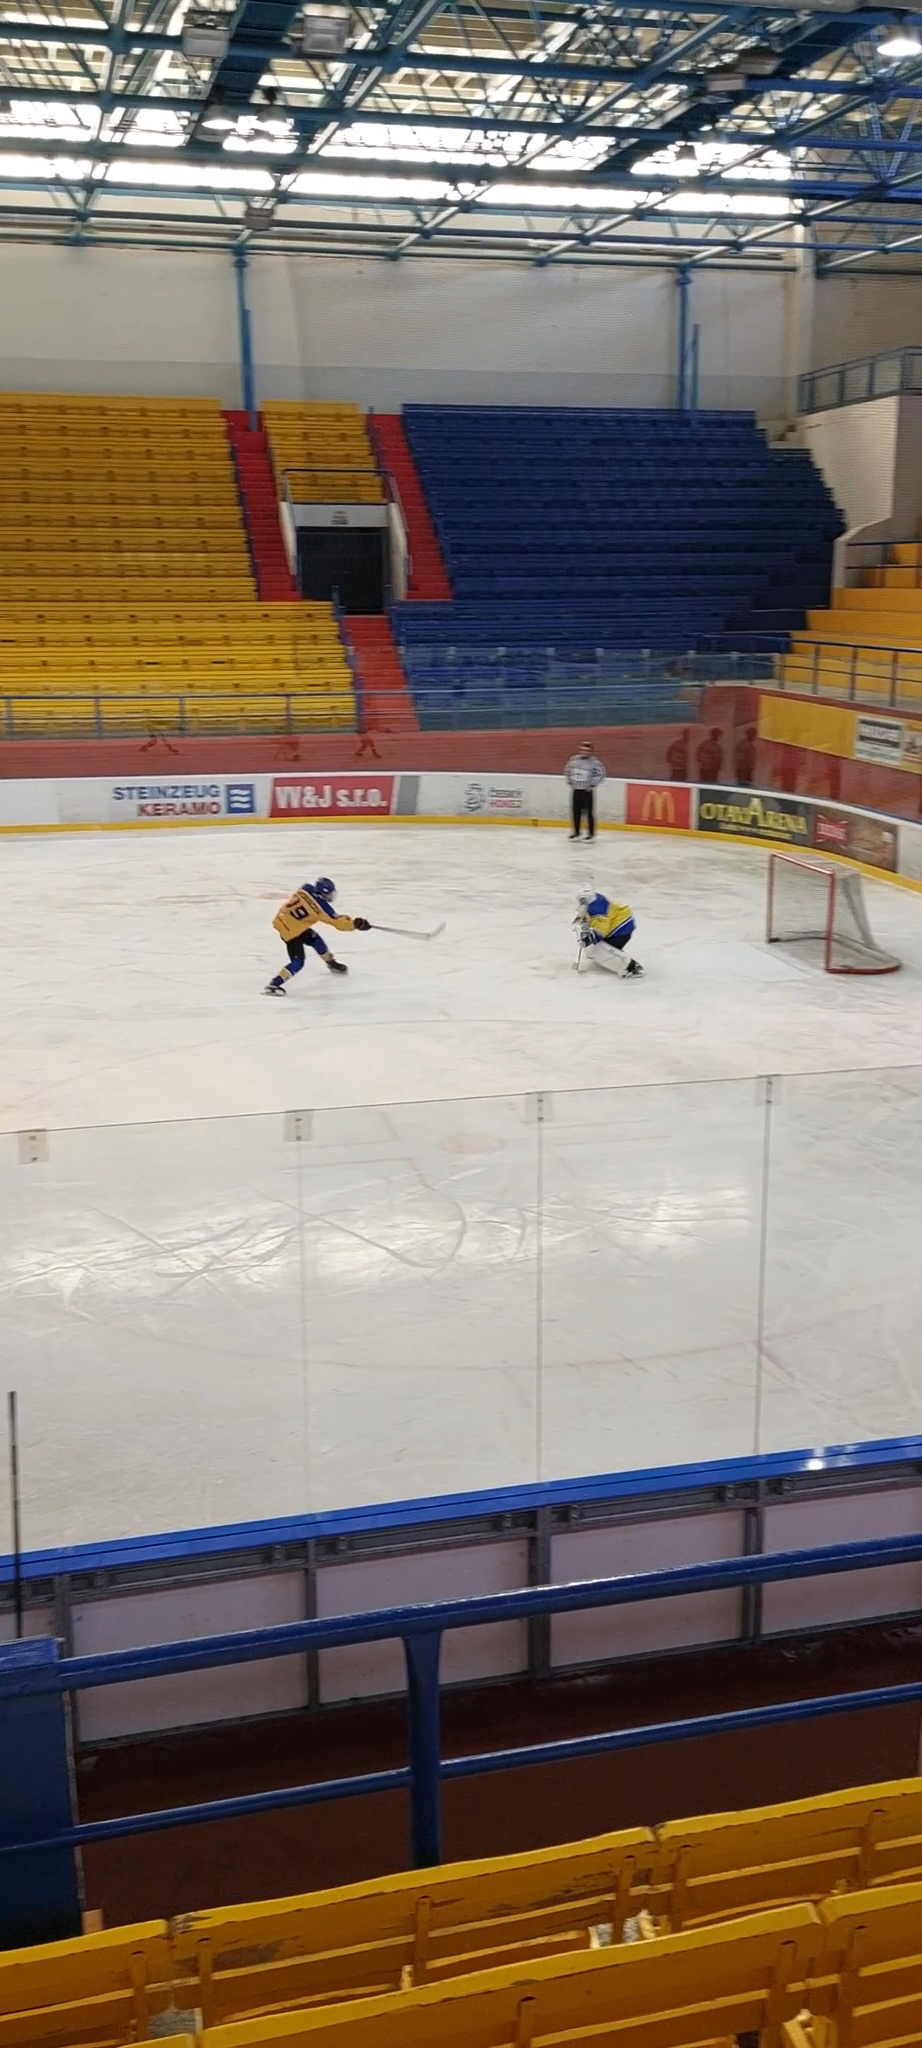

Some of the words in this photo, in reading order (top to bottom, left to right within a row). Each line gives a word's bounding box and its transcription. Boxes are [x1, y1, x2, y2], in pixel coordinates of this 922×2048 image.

[112, 783, 221, 801] STEINZEUG
[274, 785, 331, 809] W&J
[336, 788, 387, 808] s.r.o.
[137, 801, 221, 817] KERAMO
